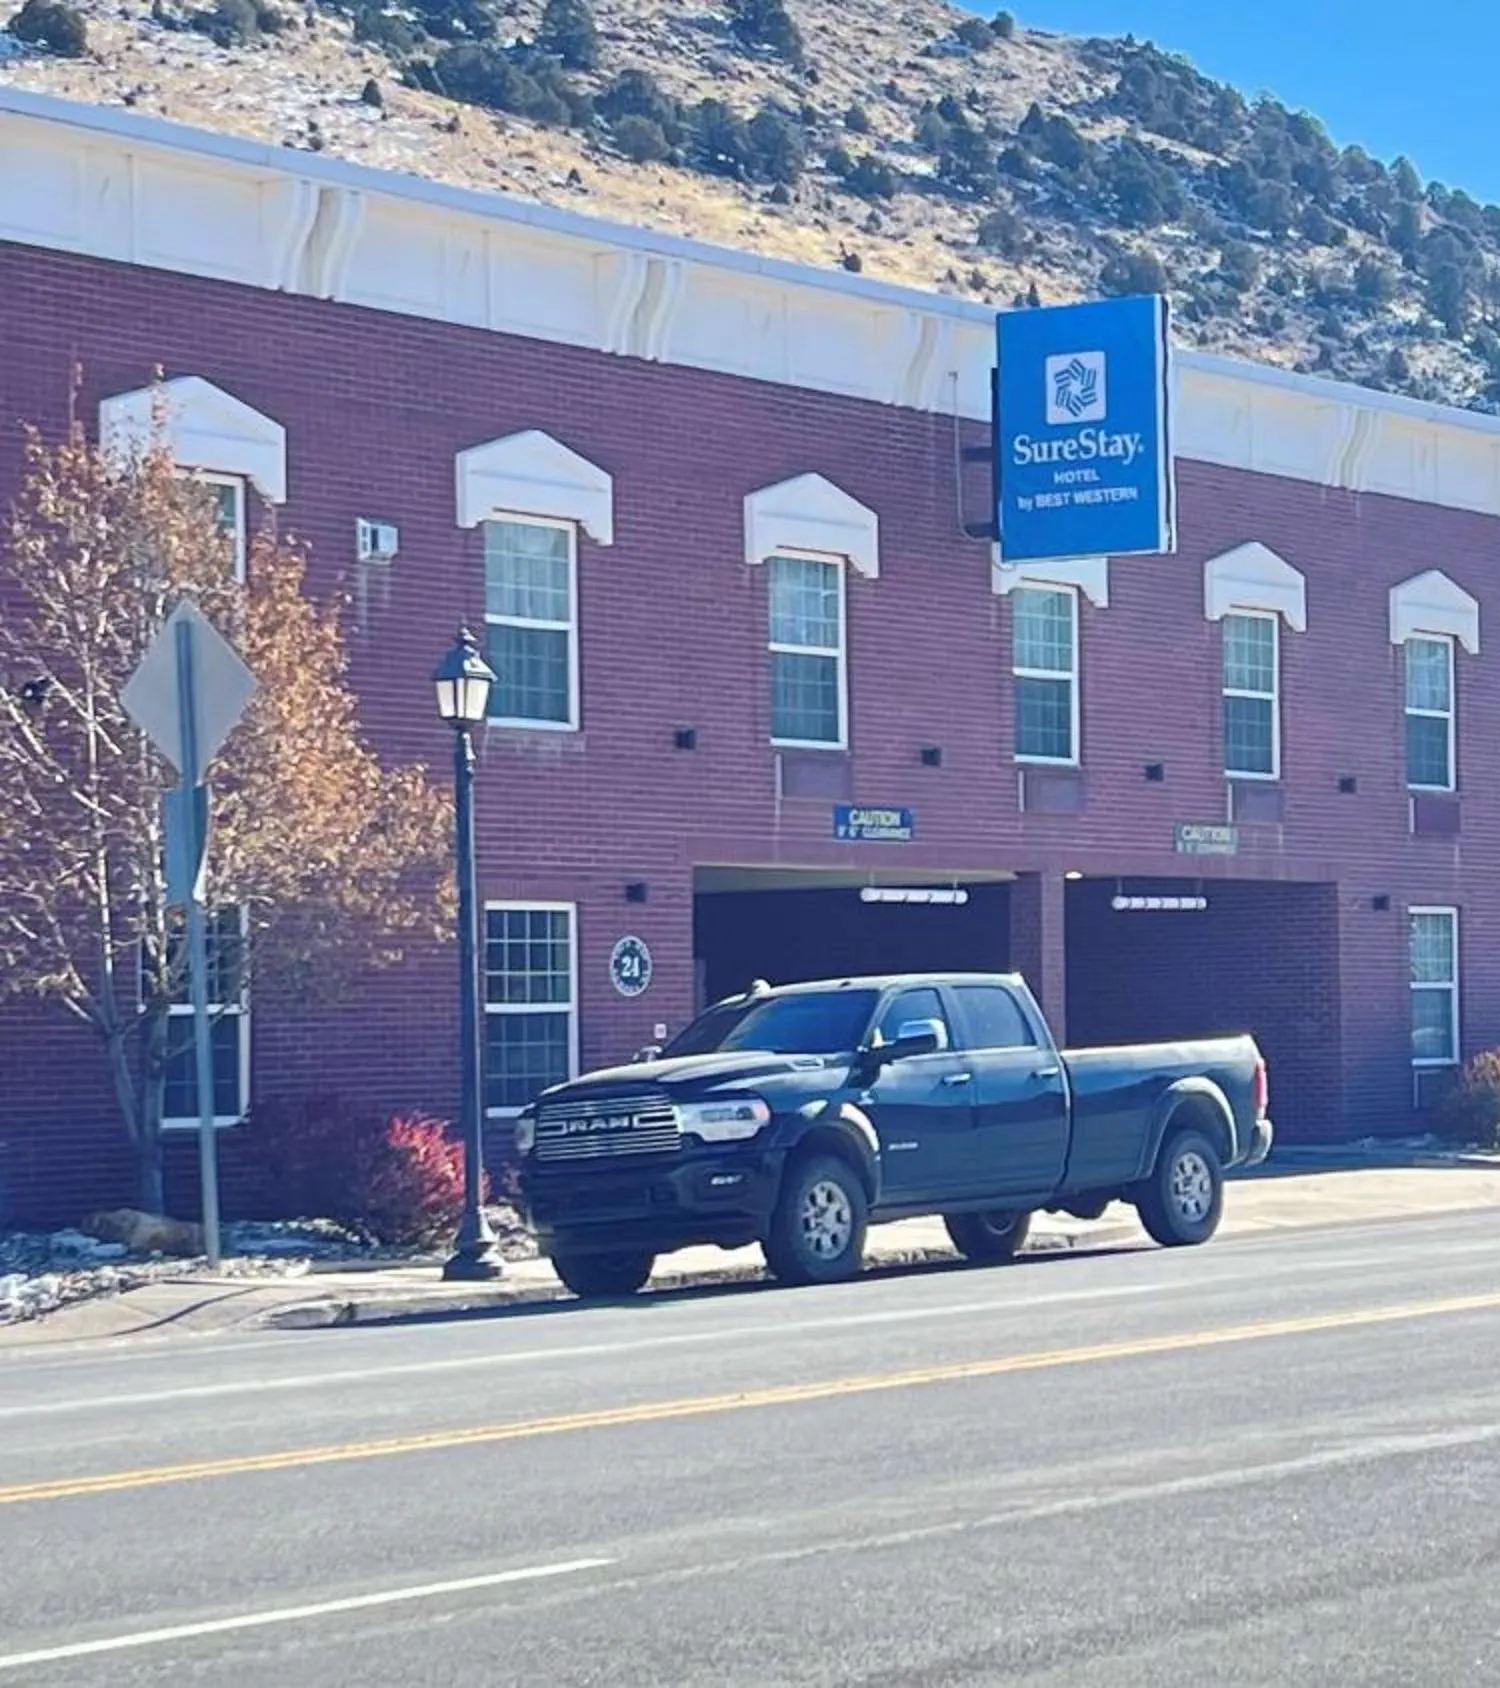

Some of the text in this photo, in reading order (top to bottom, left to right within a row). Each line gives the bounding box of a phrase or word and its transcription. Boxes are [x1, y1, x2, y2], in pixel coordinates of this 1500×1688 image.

[1054, 468, 1100, 484] HOTEL
[1018, 487, 1138, 511] by BEST WESTERN
[848, 809, 901, 826] CAUTION
[621, 955, 640, 977] 21
[569, 1115, 630, 1132] RAM
